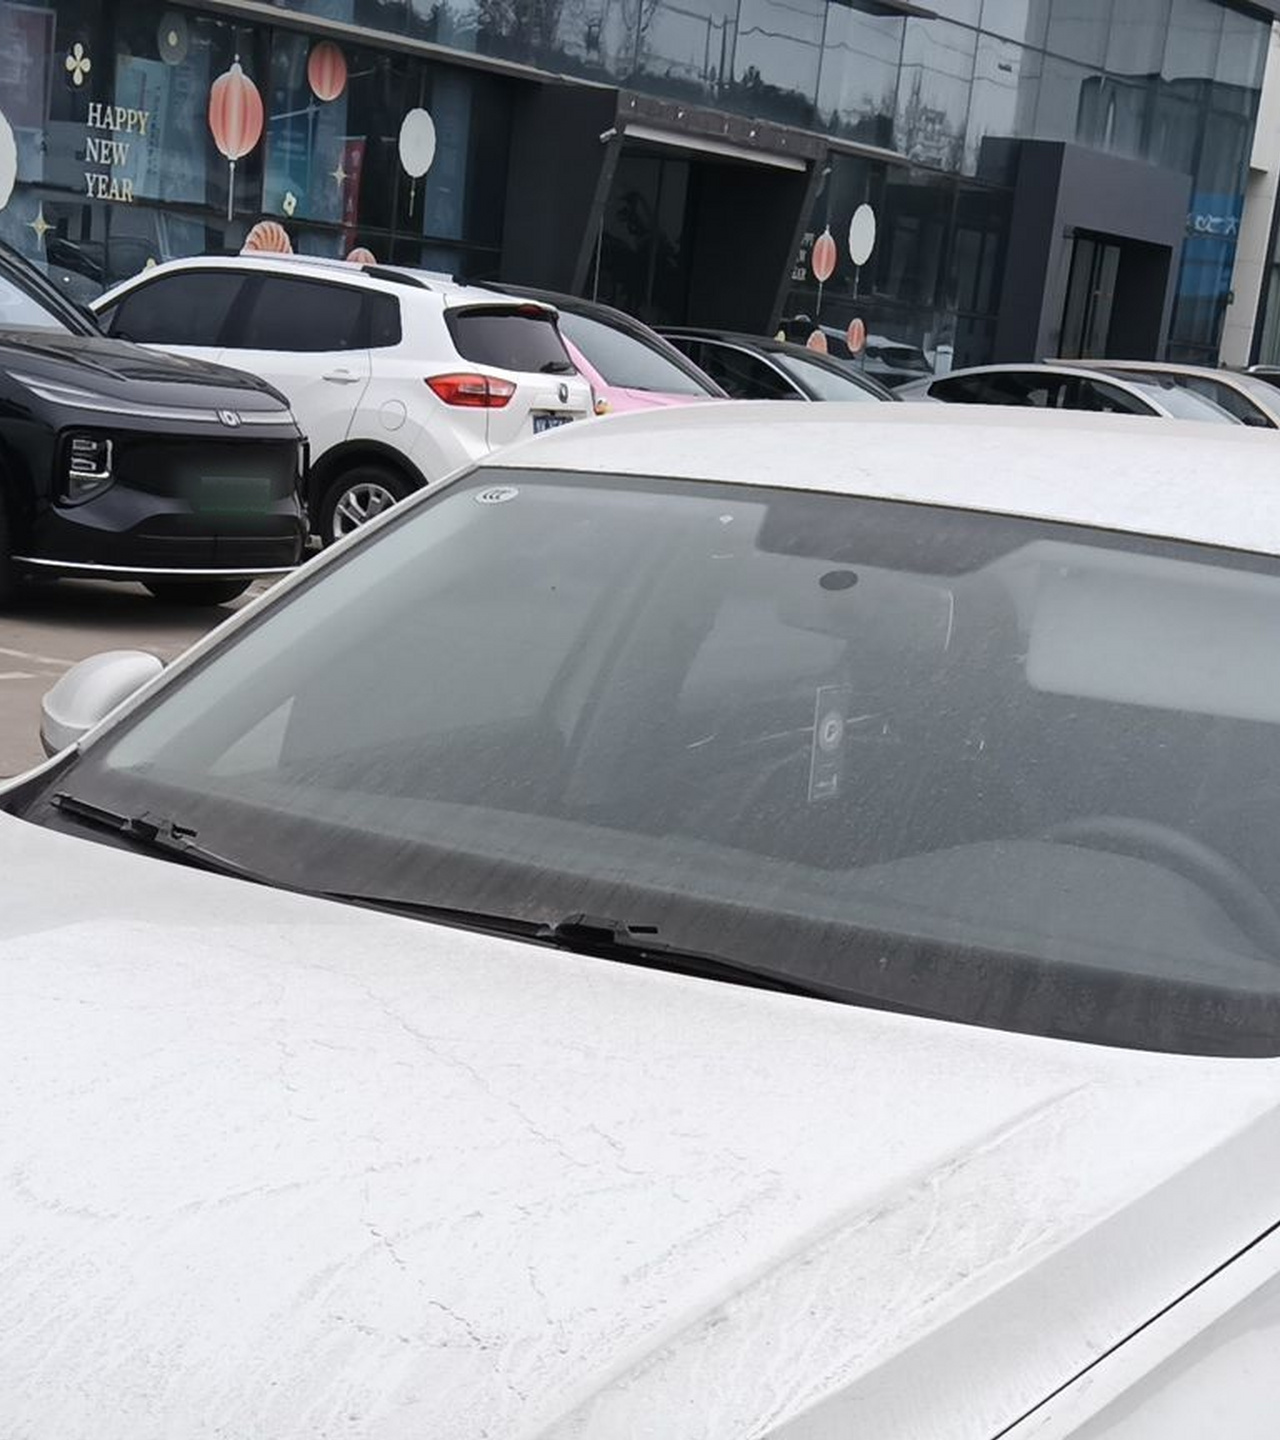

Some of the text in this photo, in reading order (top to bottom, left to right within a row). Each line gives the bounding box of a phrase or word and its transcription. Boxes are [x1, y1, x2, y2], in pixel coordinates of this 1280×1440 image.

[86, 102, 150, 135] HAPPY
[85, 137, 130, 166] NEW
[85, 172, 133, 203] YEAR
